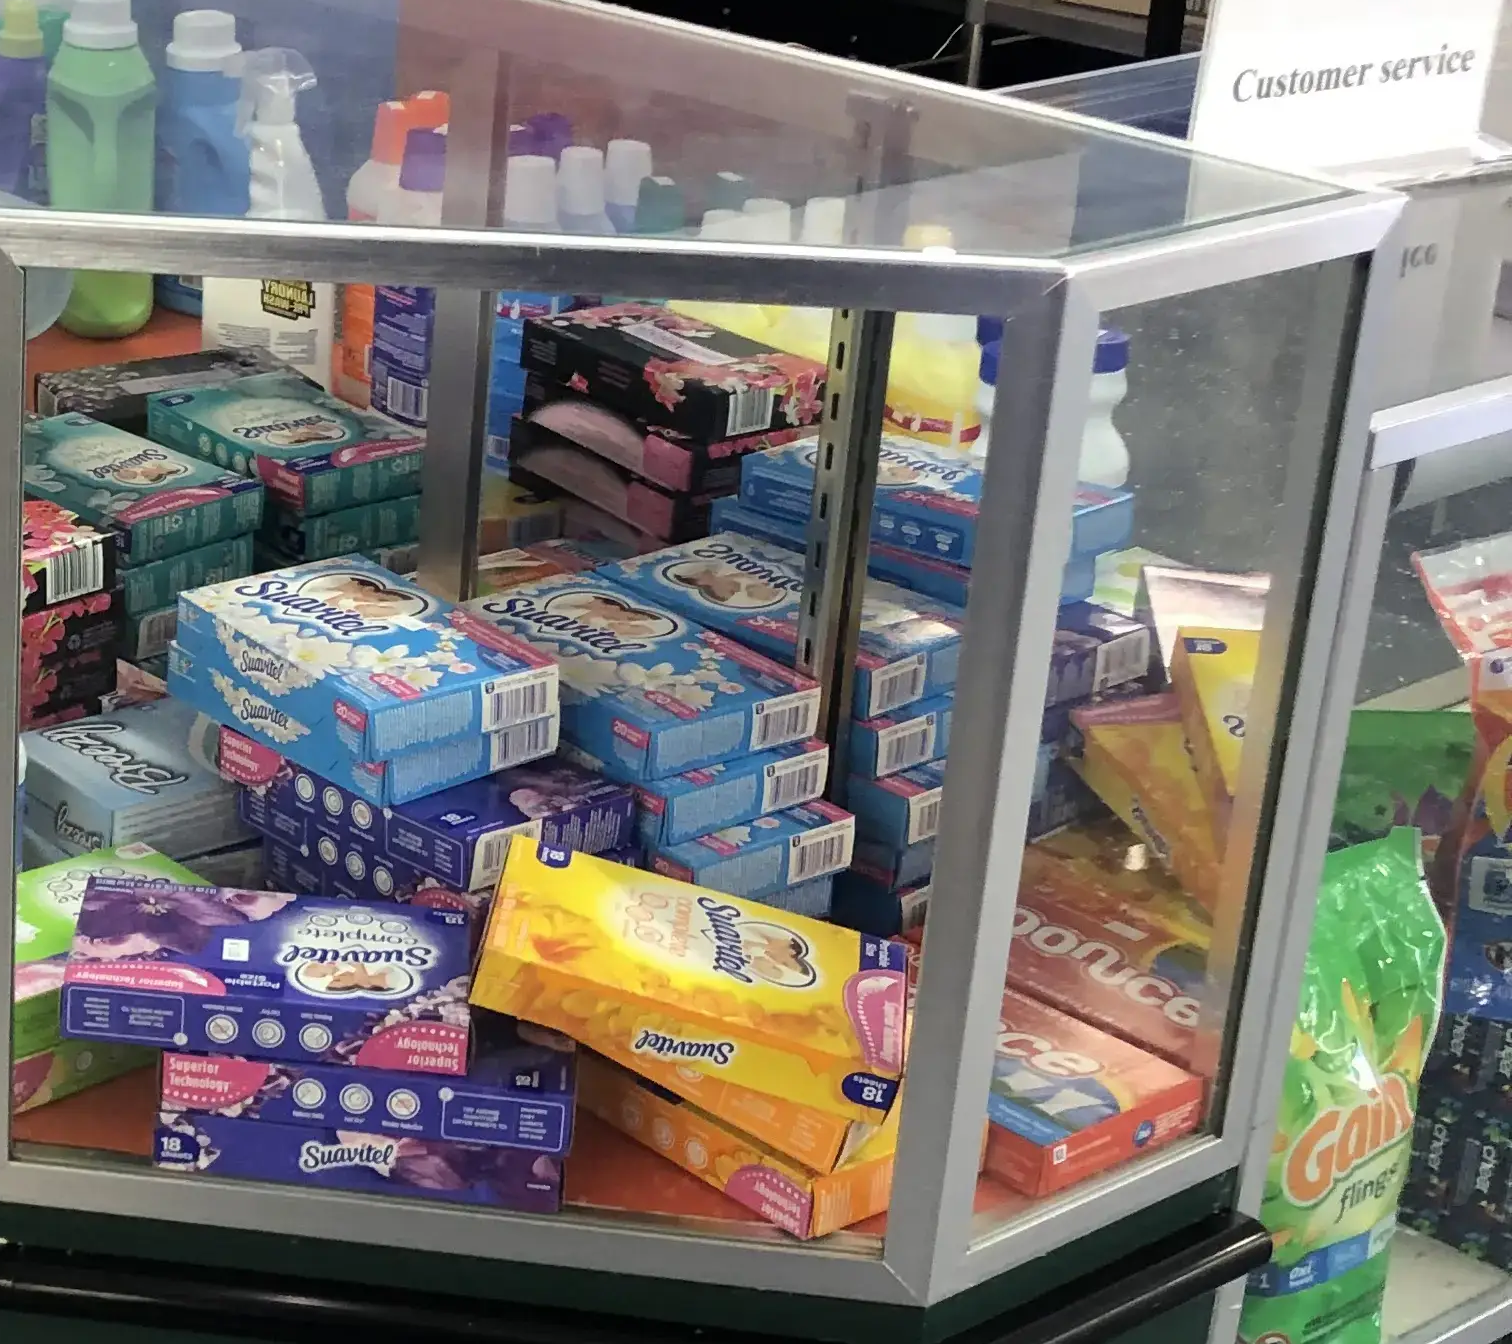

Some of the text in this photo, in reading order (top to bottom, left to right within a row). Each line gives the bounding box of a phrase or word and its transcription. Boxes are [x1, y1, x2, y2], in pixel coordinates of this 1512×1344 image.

[1232, 43, 1477, 103] Customer service
[234, 579, 390, 643] Suavitel
[482, 598, 647, 654] Suavitel
[240, 650, 286, 683] Suavitel
[40, 722, 188, 795] Breezy
[295, 927, 419, 945] complete
[668, 897, 693, 958] complete
[697, 895, 753, 984] Suavitel
[282, 945, 433, 967] Suavitel
[72, 972, 185, 990] Superior Technology
[224, 977, 281, 990] Portable
[395, 1036, 460, 1054] Technology
[633, 1029, 736, 1065] Suavitel
[168, 1057, 220, 1074] Superior
[407, 1054, 460, 1071] Superior
[169, 1071, 231, 1093] Technology
[861, 1085, 884, 1103] 18
[160, 1136, 181, 1152] 18
[1285, 1072, 1415, 1203] Gain
[302, 1143, 395, 1172] Suavitel
